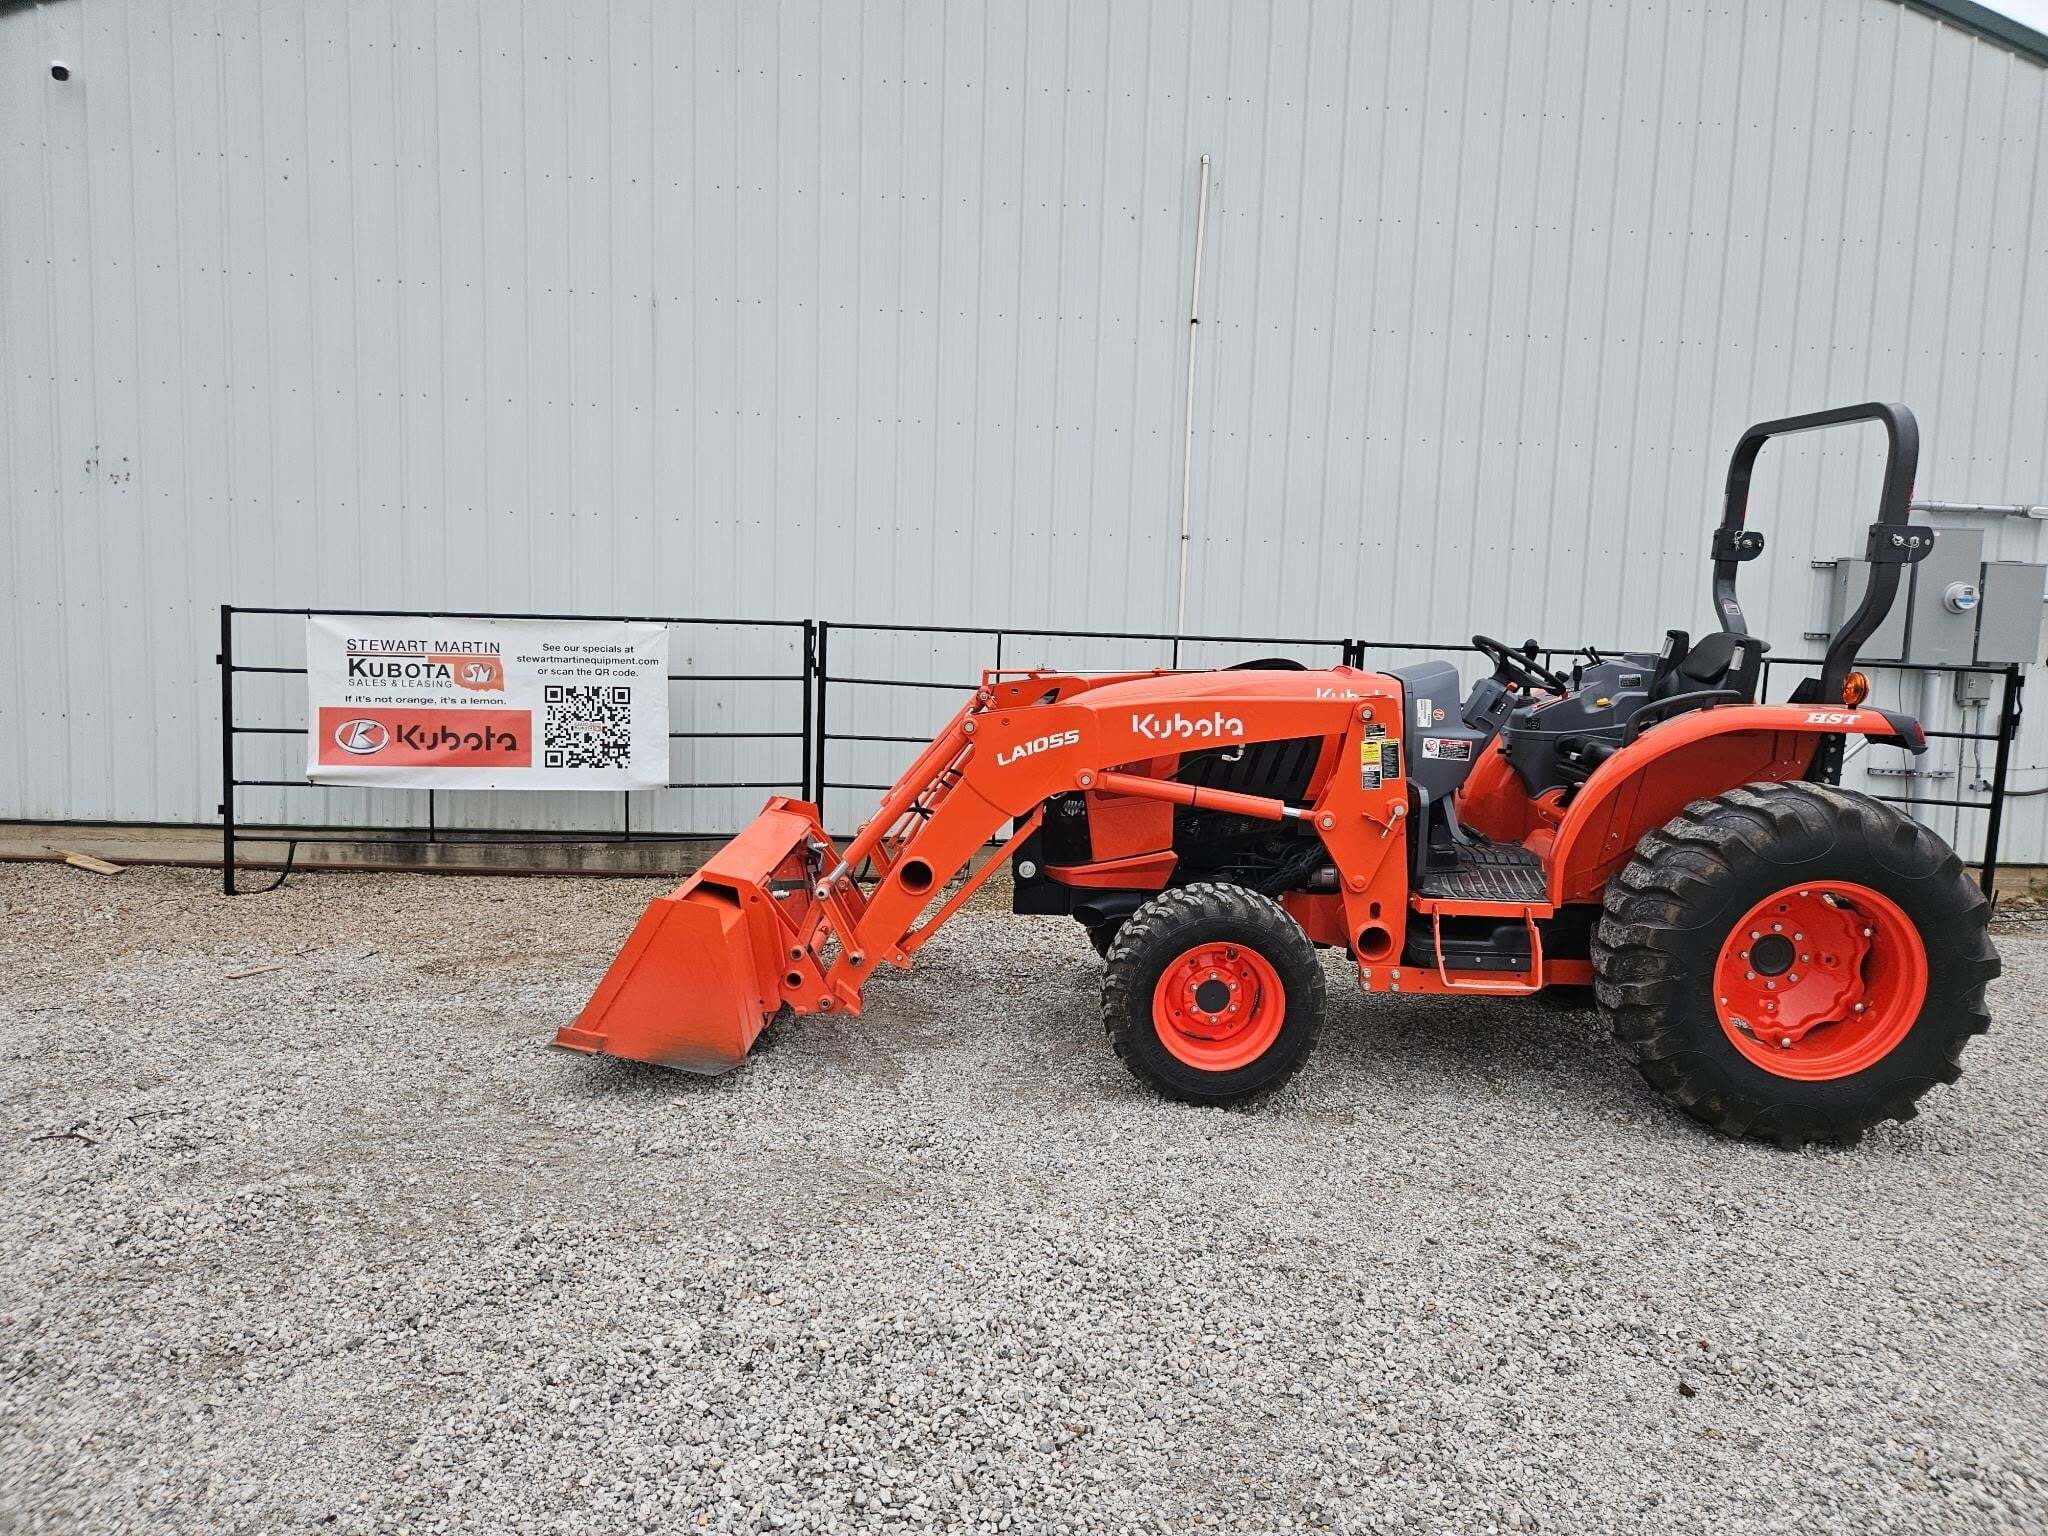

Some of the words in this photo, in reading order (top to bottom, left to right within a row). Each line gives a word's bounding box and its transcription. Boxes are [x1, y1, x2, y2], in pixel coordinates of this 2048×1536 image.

[346, 638, 427, 652] STEWART
[435, 640, 500, 654] MARTIN
[542, 643, 561, 652] See
[582, 645, 622, 654] specials
[624, 645, 634, 653] at
[516, 655, 659, 665] stewartmartinequipment.com
[349, 657, 451, 679] KUBOTA
[550, 668, 574, 676] scan
[576, 668, 592, 676] the
[594, 668, 610, 677] QR
[612, 668, 639, 677] code.
[348, 678, 387, 687] SALES
[391, 679, 398, 687] &
[401, 679, 453, 688] LEASING
[345, 695, 353, 703] If
[355, 695, 372, 703] it's
[374, 696, 393, 704] not
[395, 697, 437, 706] orange,
[440, 697, 457, 705] it's
[470, 697, 507, 705] lemon.
[1131, 711, 1244, 739] Kubota
[1804, 711, 1861, 726] HST
[396, 724, 518, 751] Kubota
[996, 729, 1080, 767] LA1055
